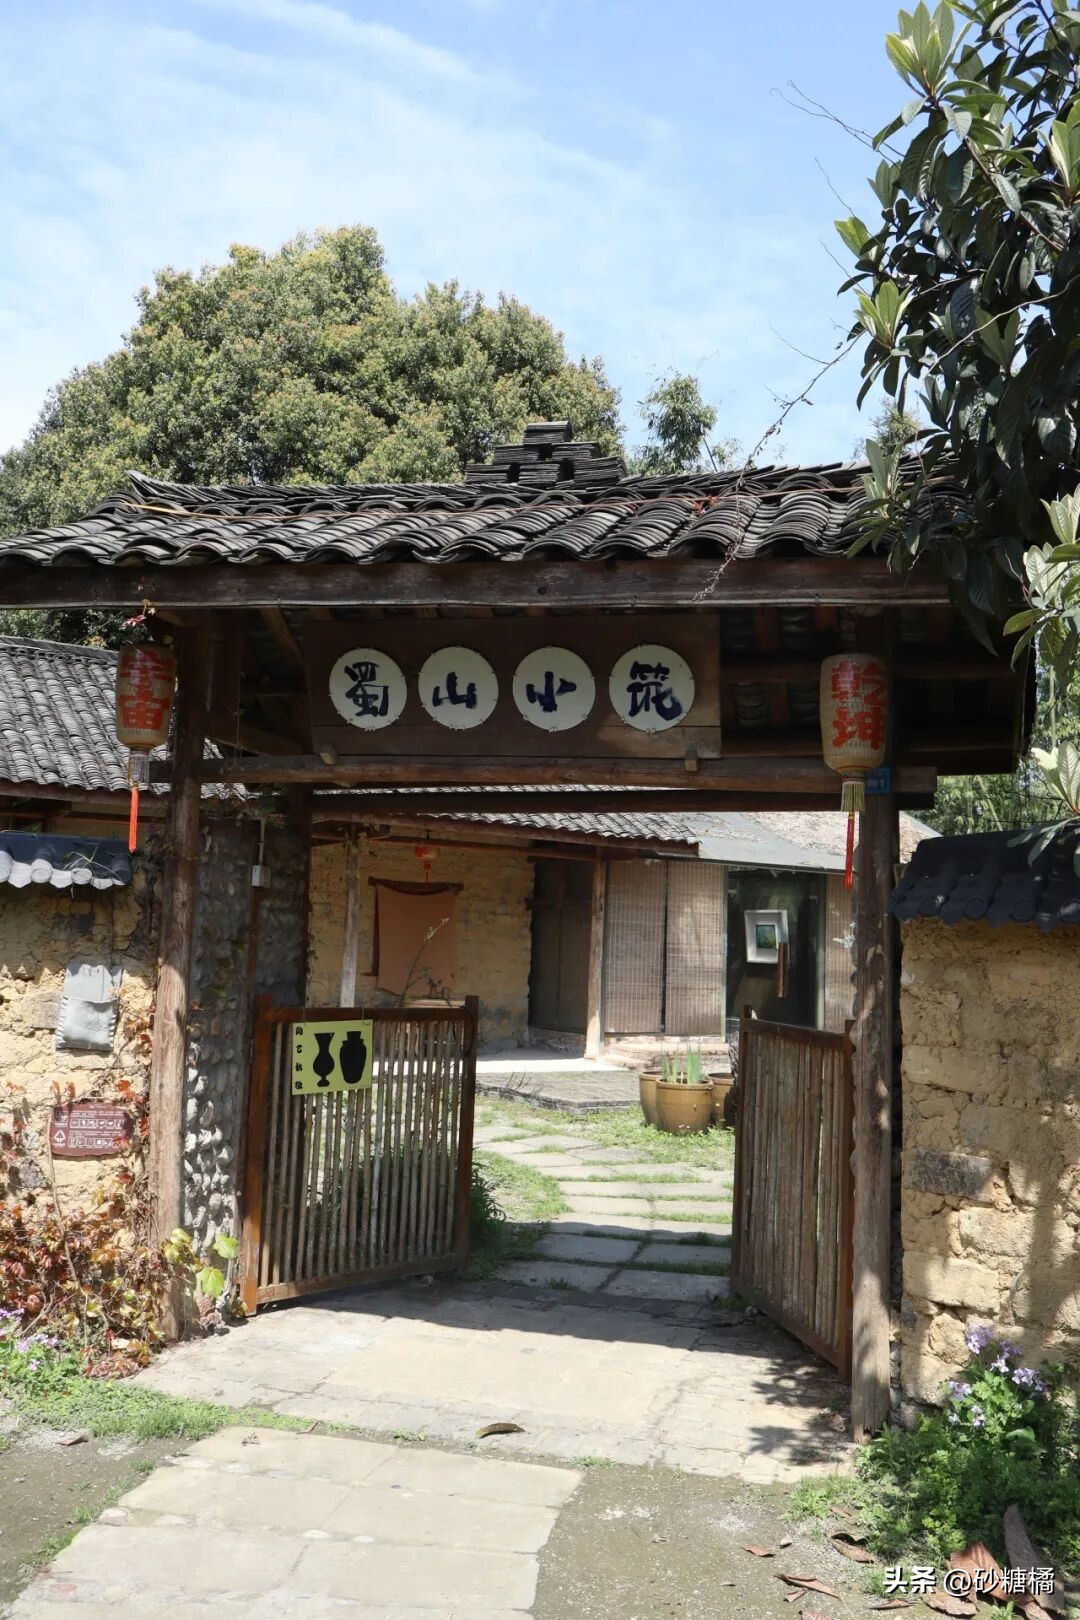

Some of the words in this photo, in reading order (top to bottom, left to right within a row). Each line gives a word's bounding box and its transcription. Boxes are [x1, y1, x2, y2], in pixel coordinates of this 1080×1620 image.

[345, 661, 683, 721] 蜀山小筑
[831, 660, 887, 751] 乾坤
